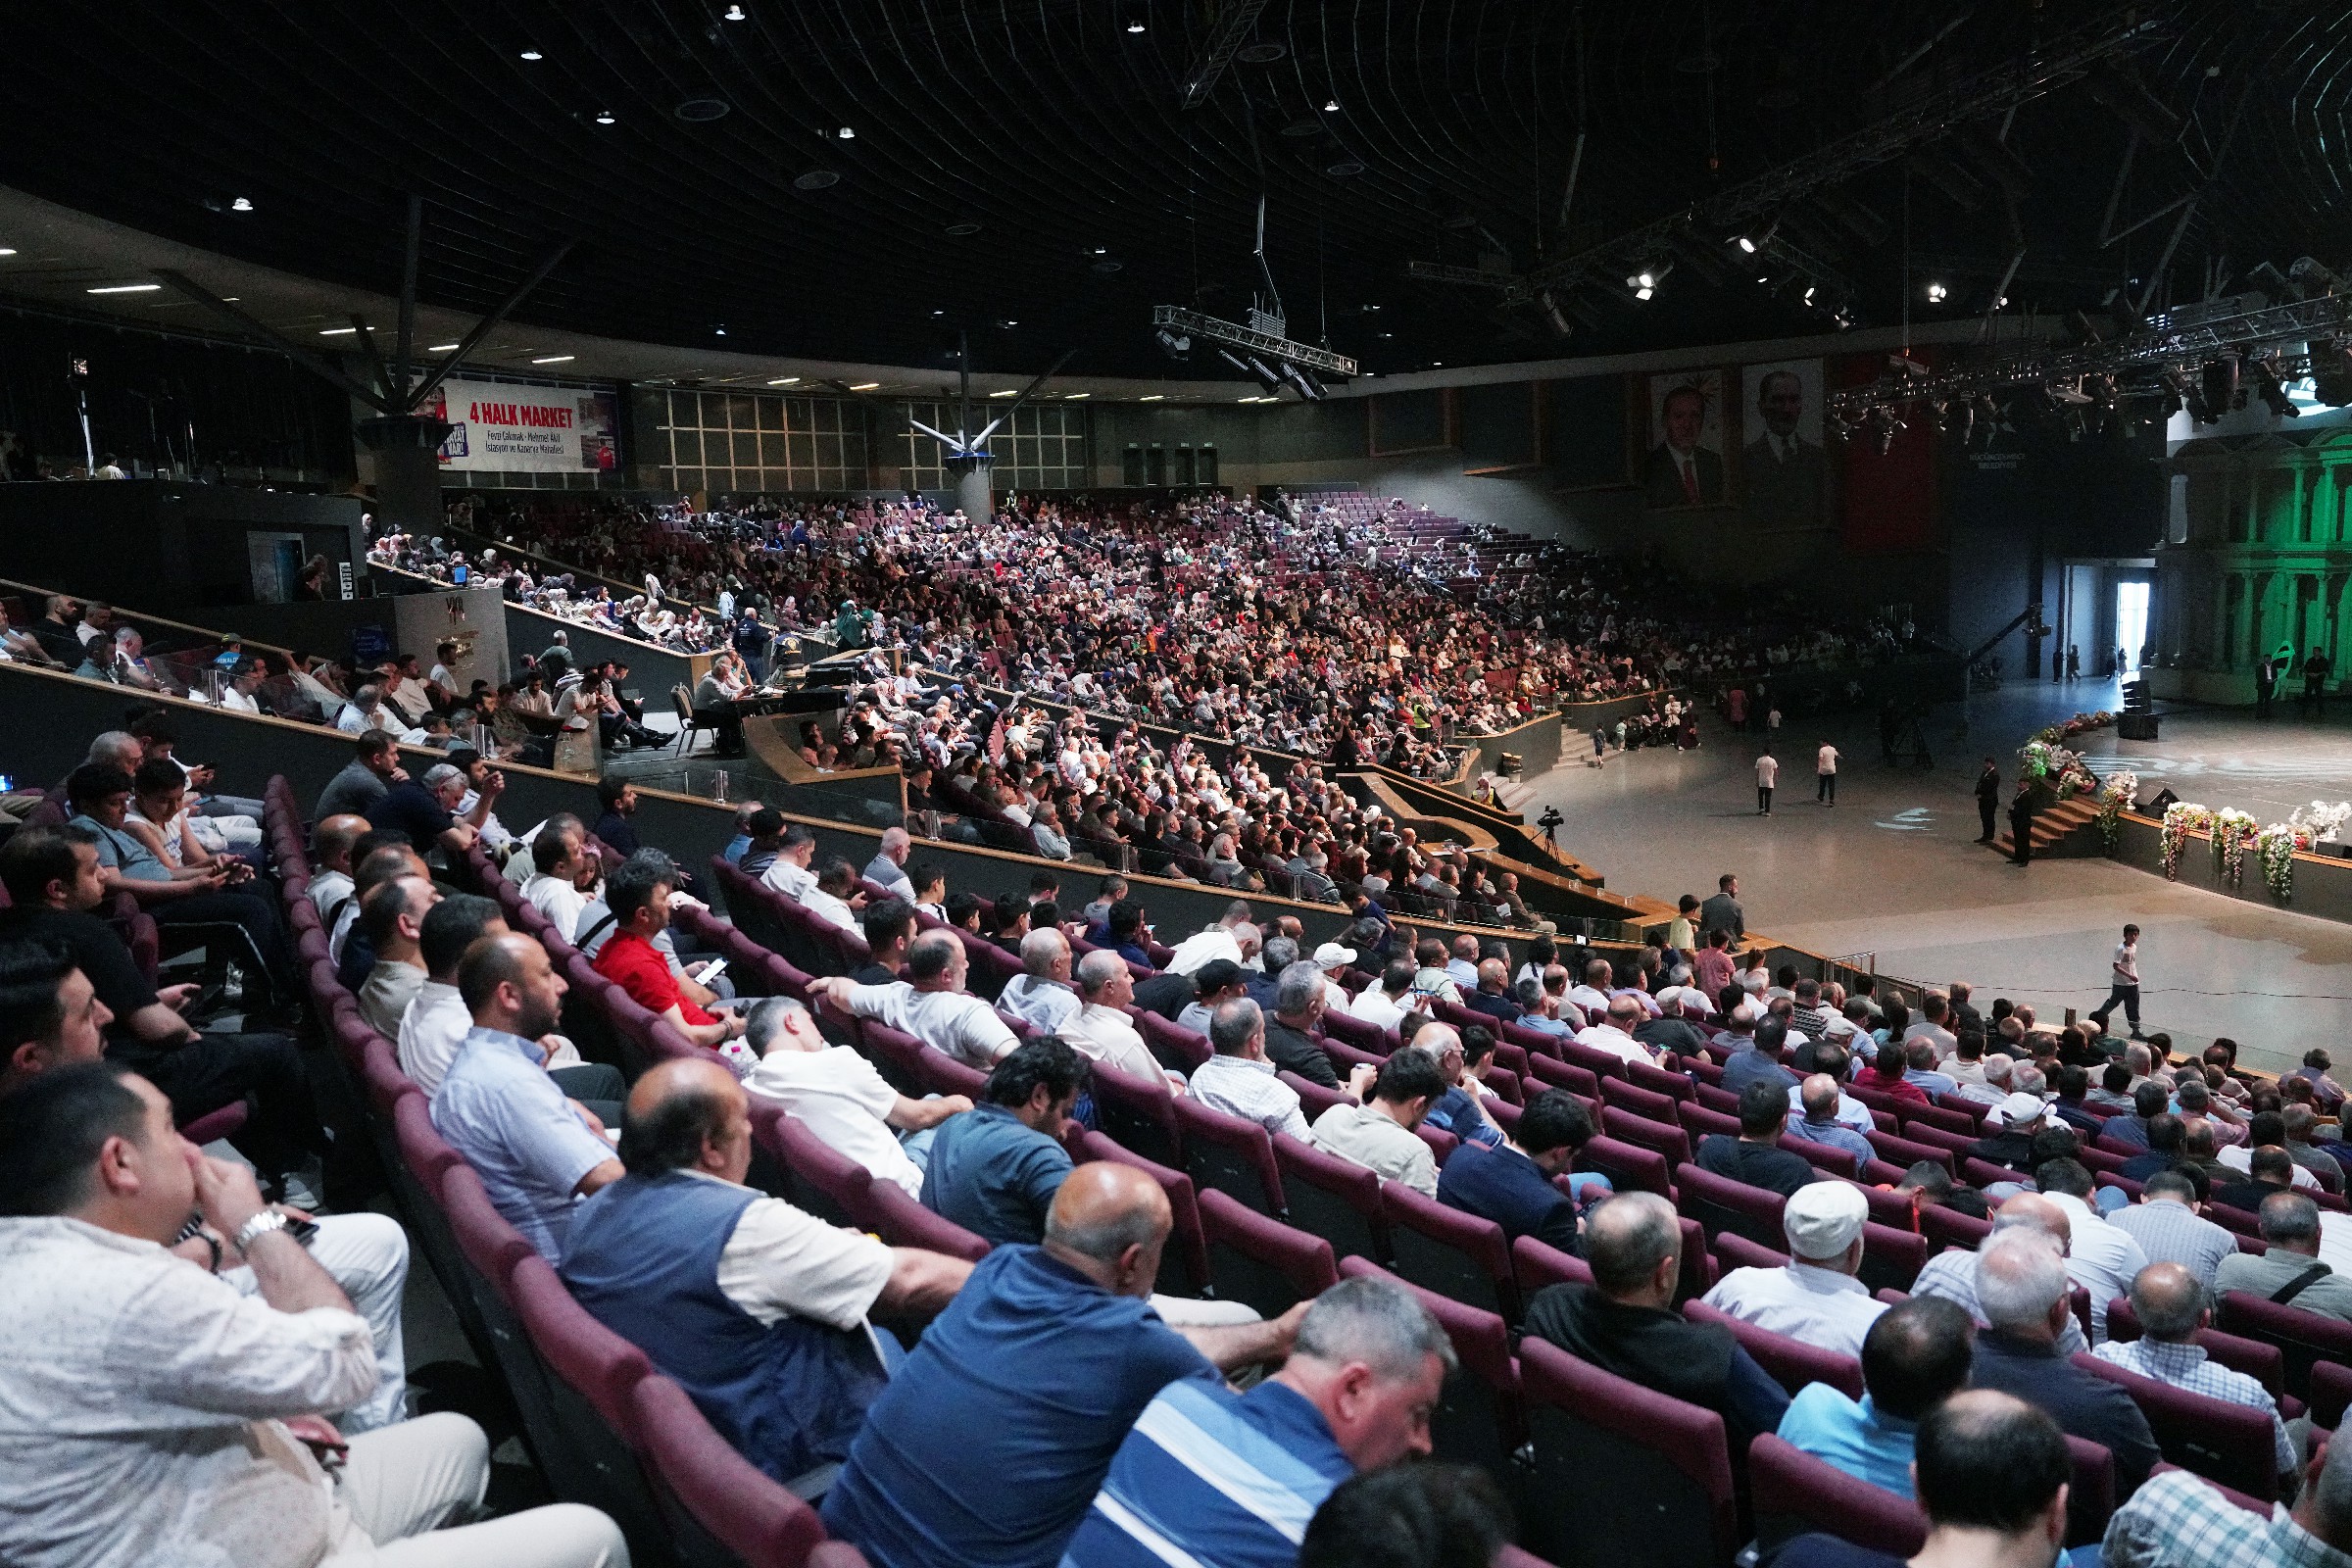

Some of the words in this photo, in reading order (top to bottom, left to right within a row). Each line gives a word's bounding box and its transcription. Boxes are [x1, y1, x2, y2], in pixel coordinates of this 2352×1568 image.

[470, 402, 479, 423] 4
[481, 403, 518, 425] HALK
[520, 406, 572, 428] MARKET
